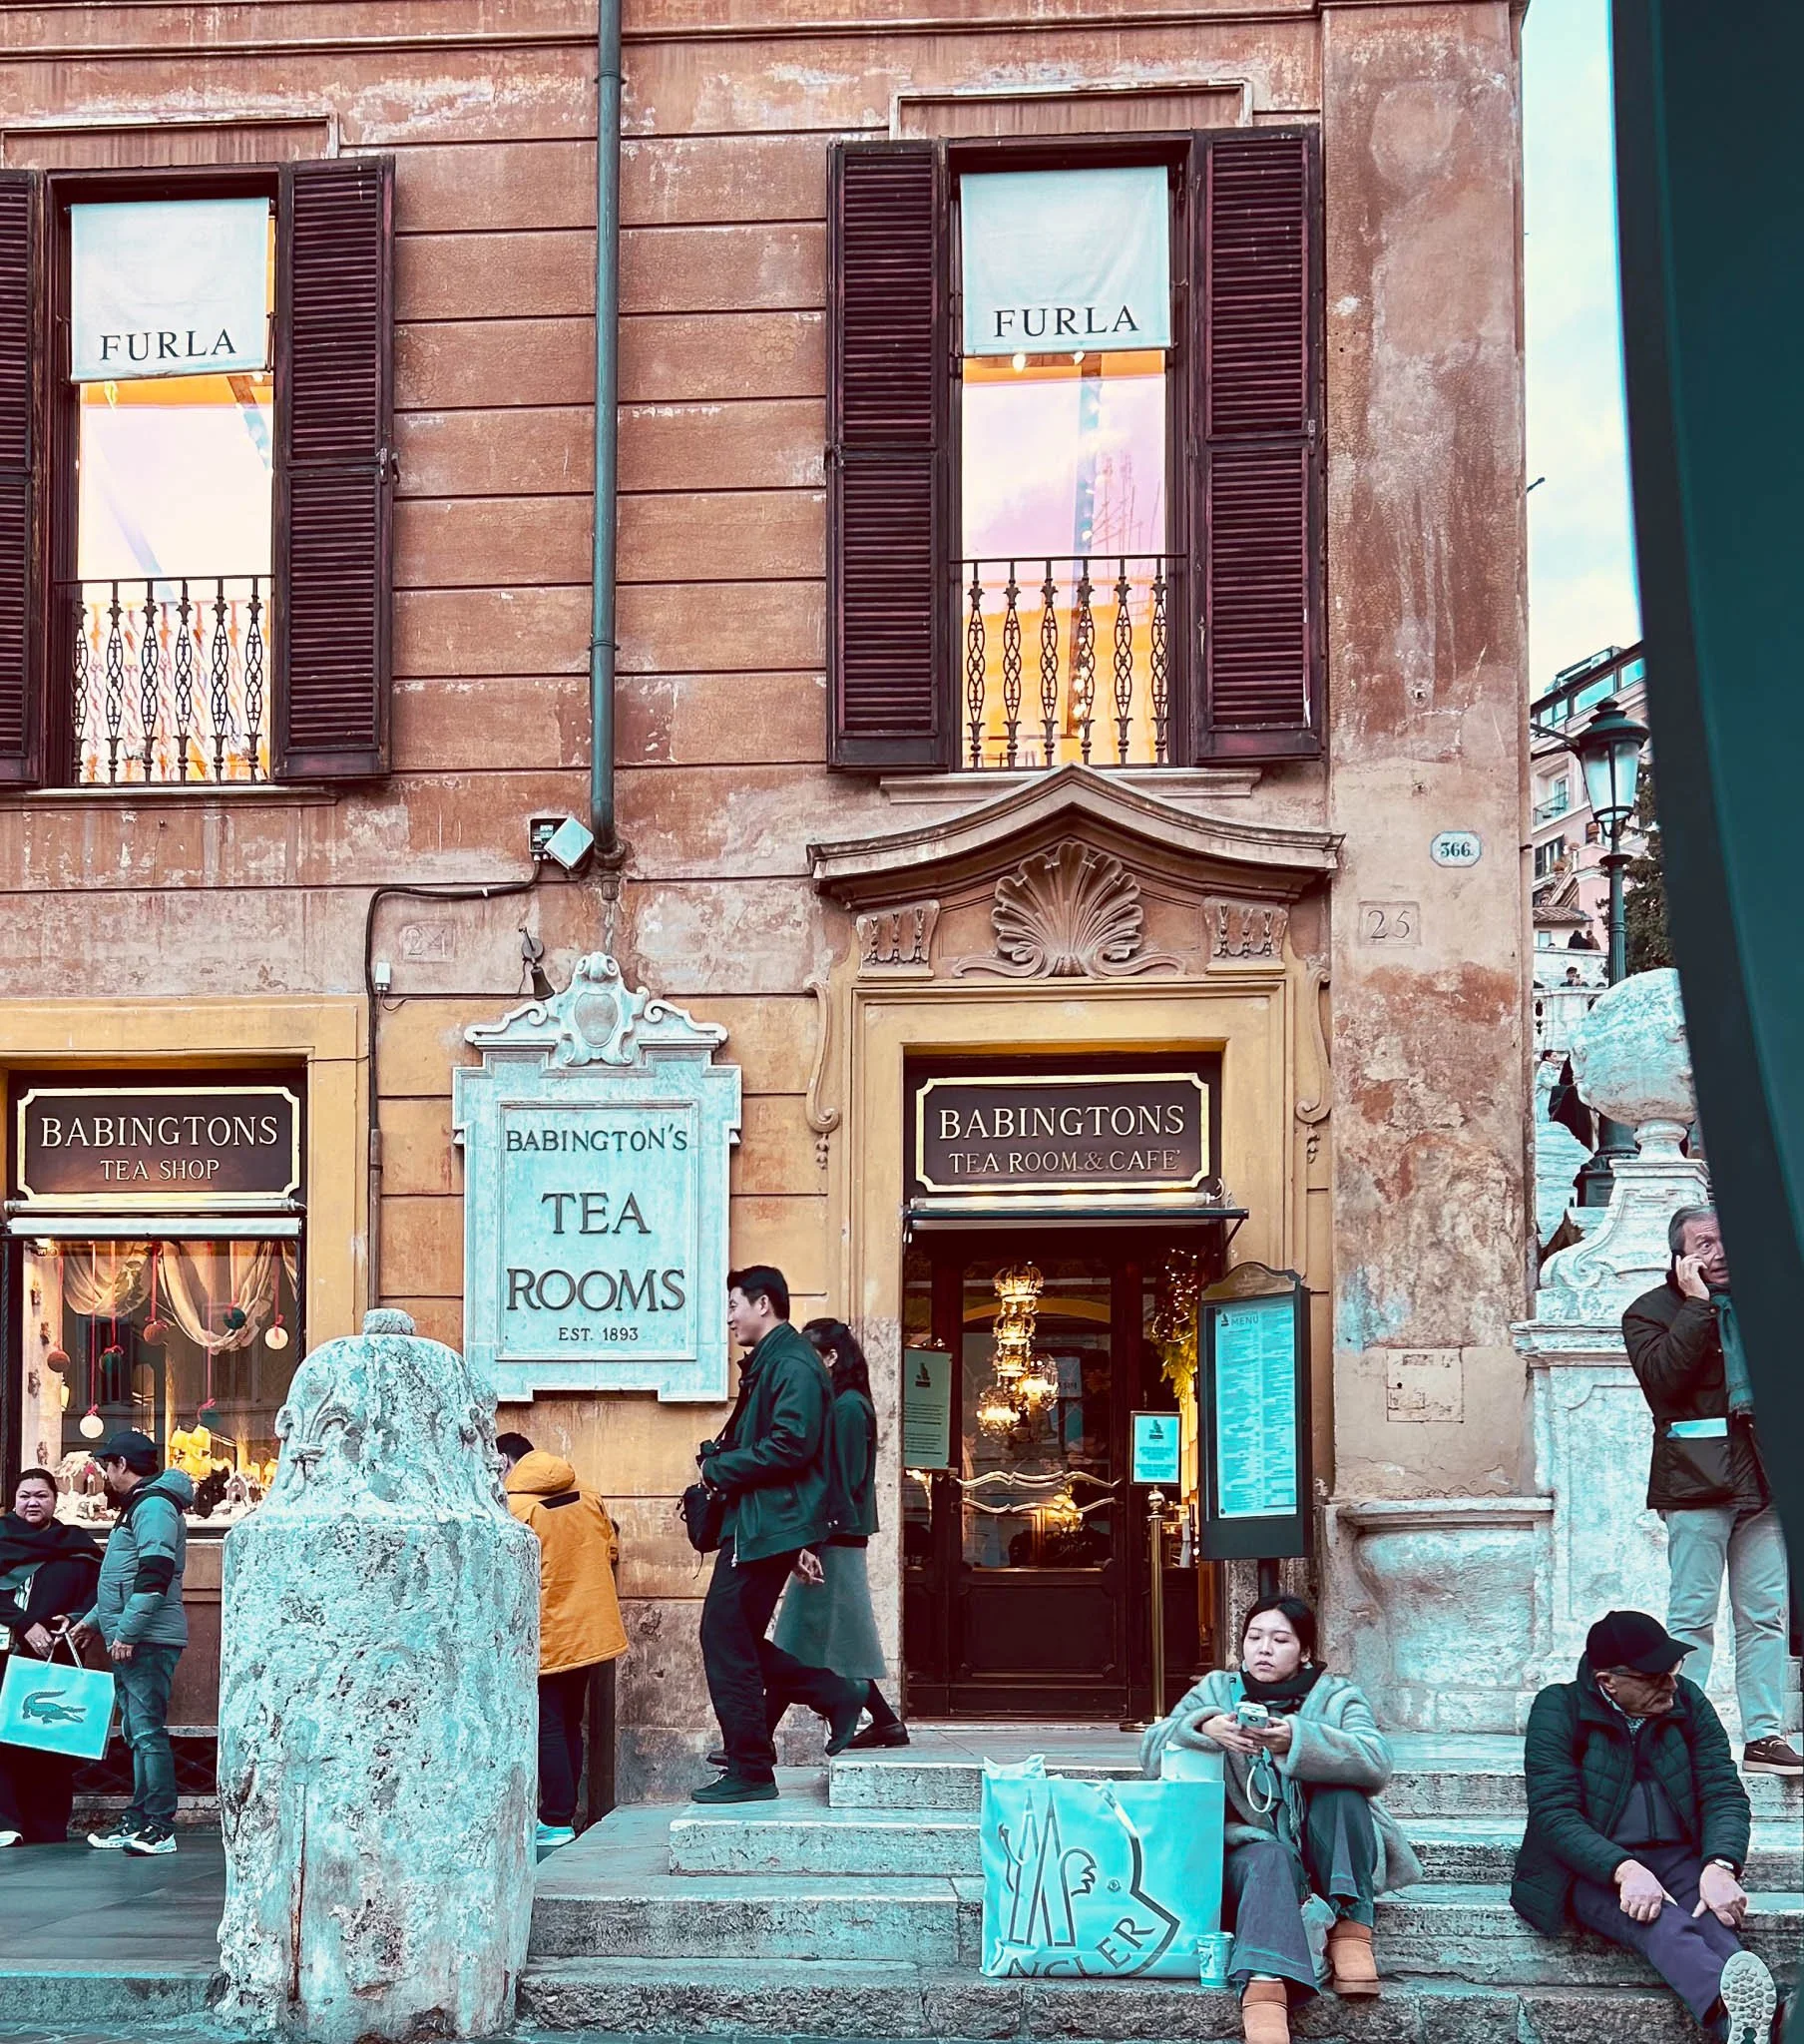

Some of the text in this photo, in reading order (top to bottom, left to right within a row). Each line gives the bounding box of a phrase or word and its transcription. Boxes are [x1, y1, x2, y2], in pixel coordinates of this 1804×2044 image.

[993, 304, 1140, 337] FURLA
[99, 327, 237, 361] FURLA
[1367, 909, 1411, 939] 25
[402, 926, 449, 956] 24
[40, 1116, 278, 1148] BABINGTONS
[939, 1104, 1185, 1141] BABINGTONS
[506, 1124, 688, 1153] BABINGTON'S
[100, 1159, 221, 1182] TEA SHOP
[949, 1152, 1000, 1175] TEA
[1009, 1150, 1078, 1174] ROOM
[1084, 1150, 1104, 1172] &
[541, 1192, 652, 1235] TEA
[506, 1268, 686, 1312] ROOMS
[558, 1326, 639, 1341] EST. 1893
[1230, 1314, 1259, 1326] MENU
